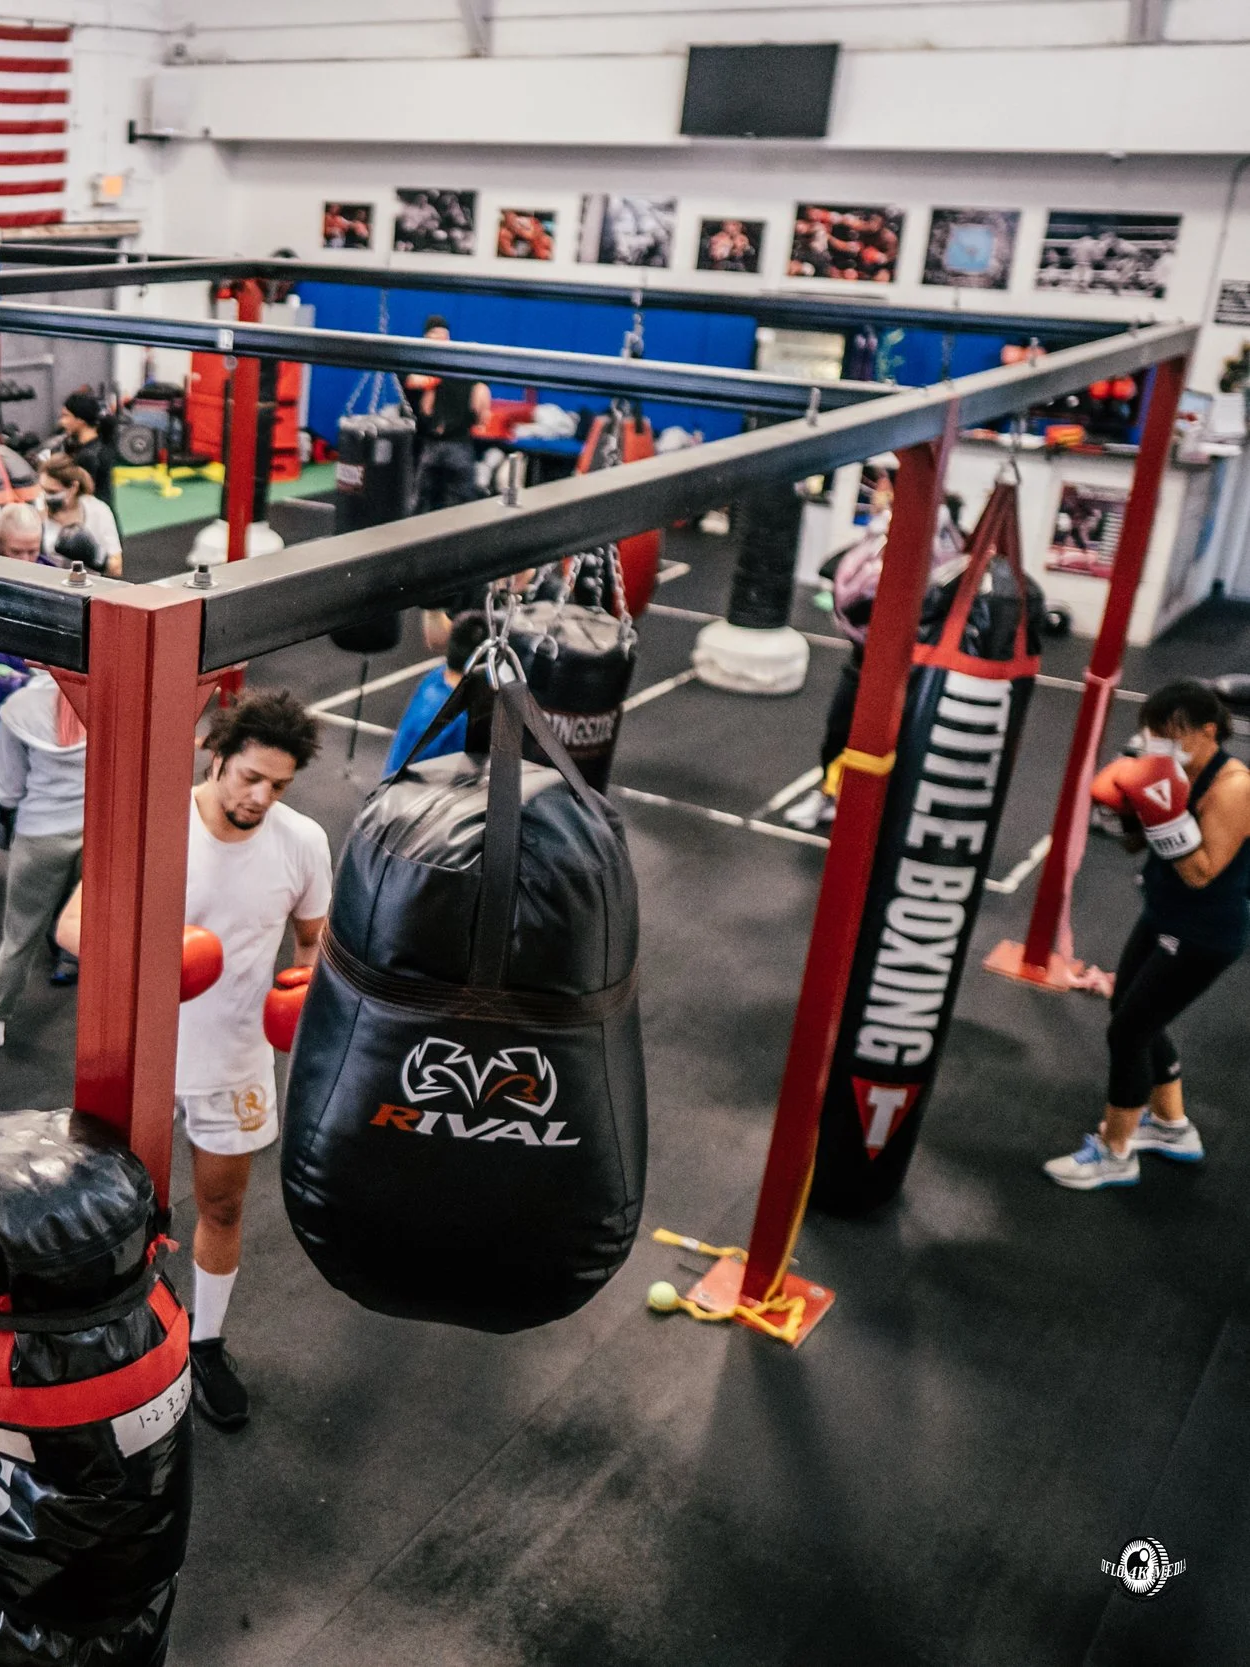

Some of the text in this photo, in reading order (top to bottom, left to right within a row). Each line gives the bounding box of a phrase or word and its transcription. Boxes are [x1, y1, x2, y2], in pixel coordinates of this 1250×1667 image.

[855, 670, 1013, 1068] TITLE BOXING
[370, 1103, 581, 1146] RIVAL
